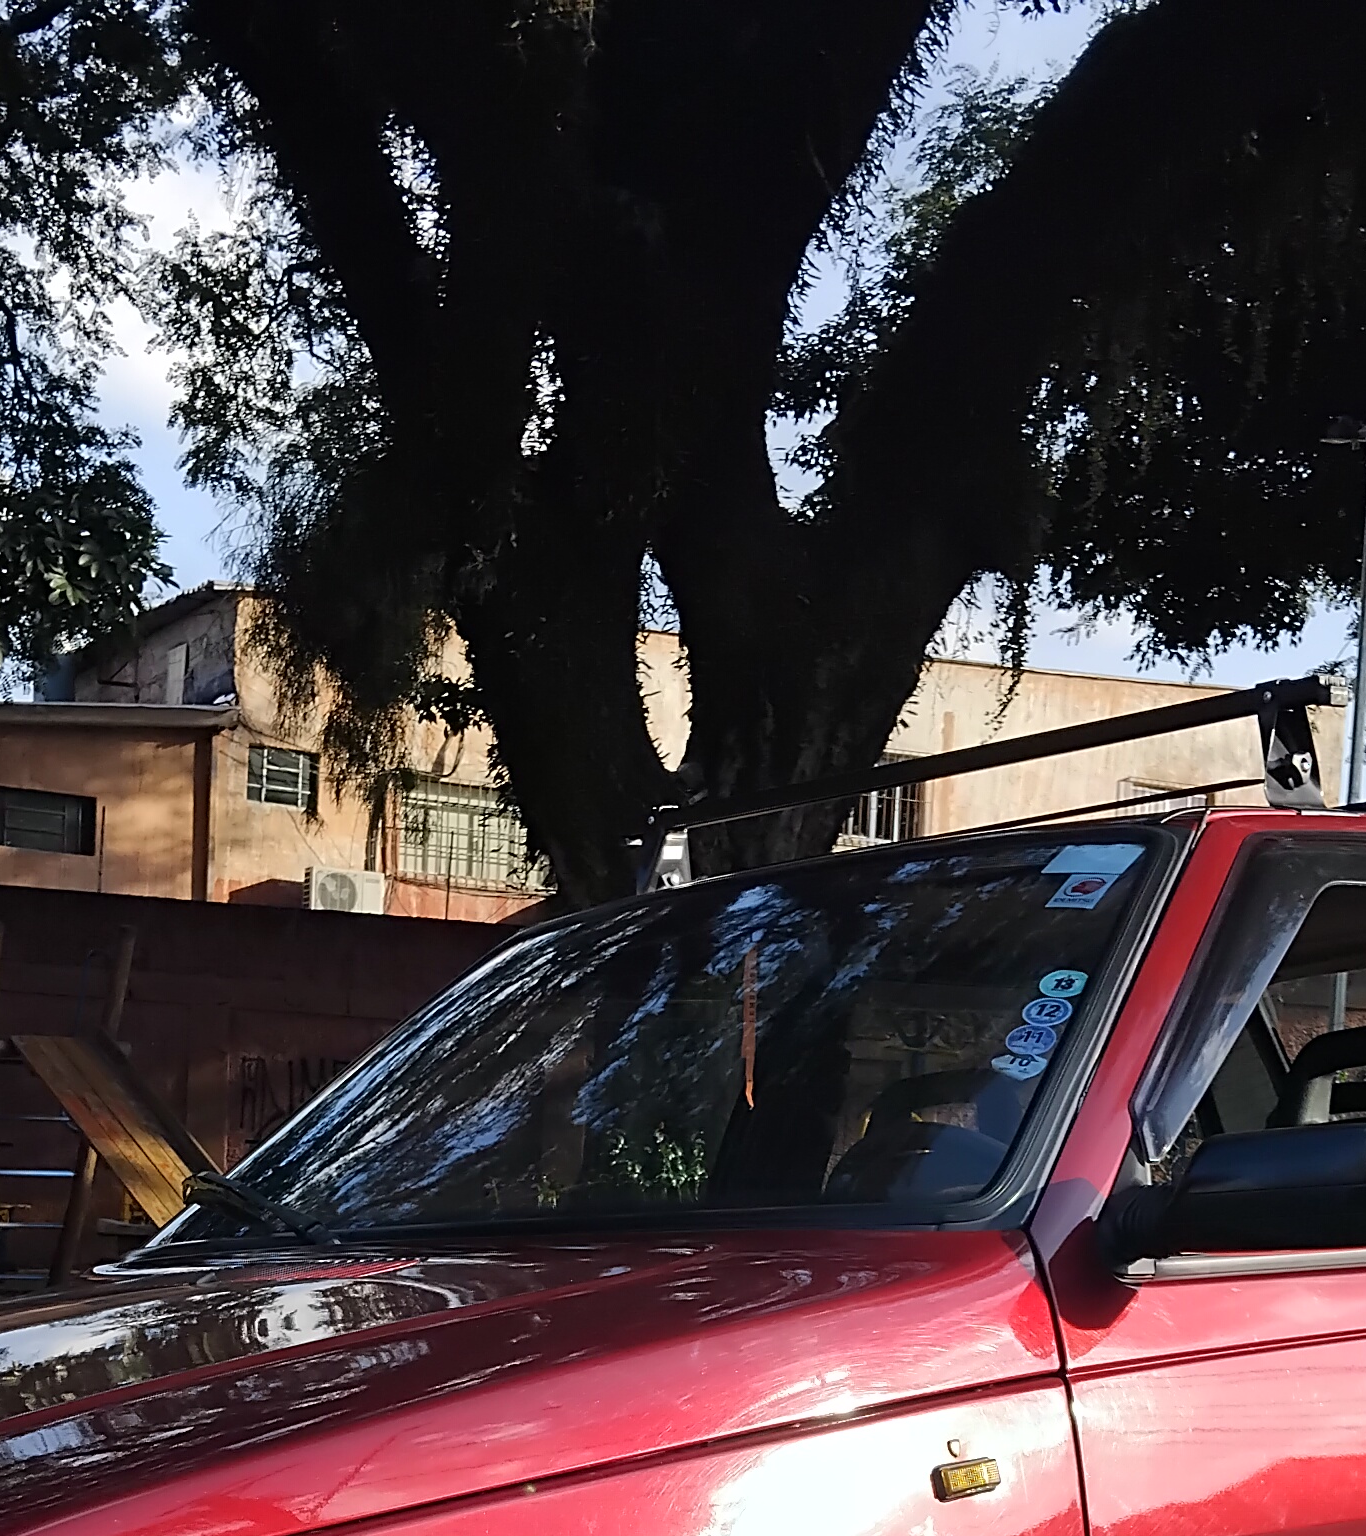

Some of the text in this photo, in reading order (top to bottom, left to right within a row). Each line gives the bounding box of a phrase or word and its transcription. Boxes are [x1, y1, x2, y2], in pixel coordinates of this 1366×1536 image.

[1053, 977, 1076, 990] 13
[1035, 1003, 1062, 1018] 12
[1021, 1030, 1045, 1044] 11
